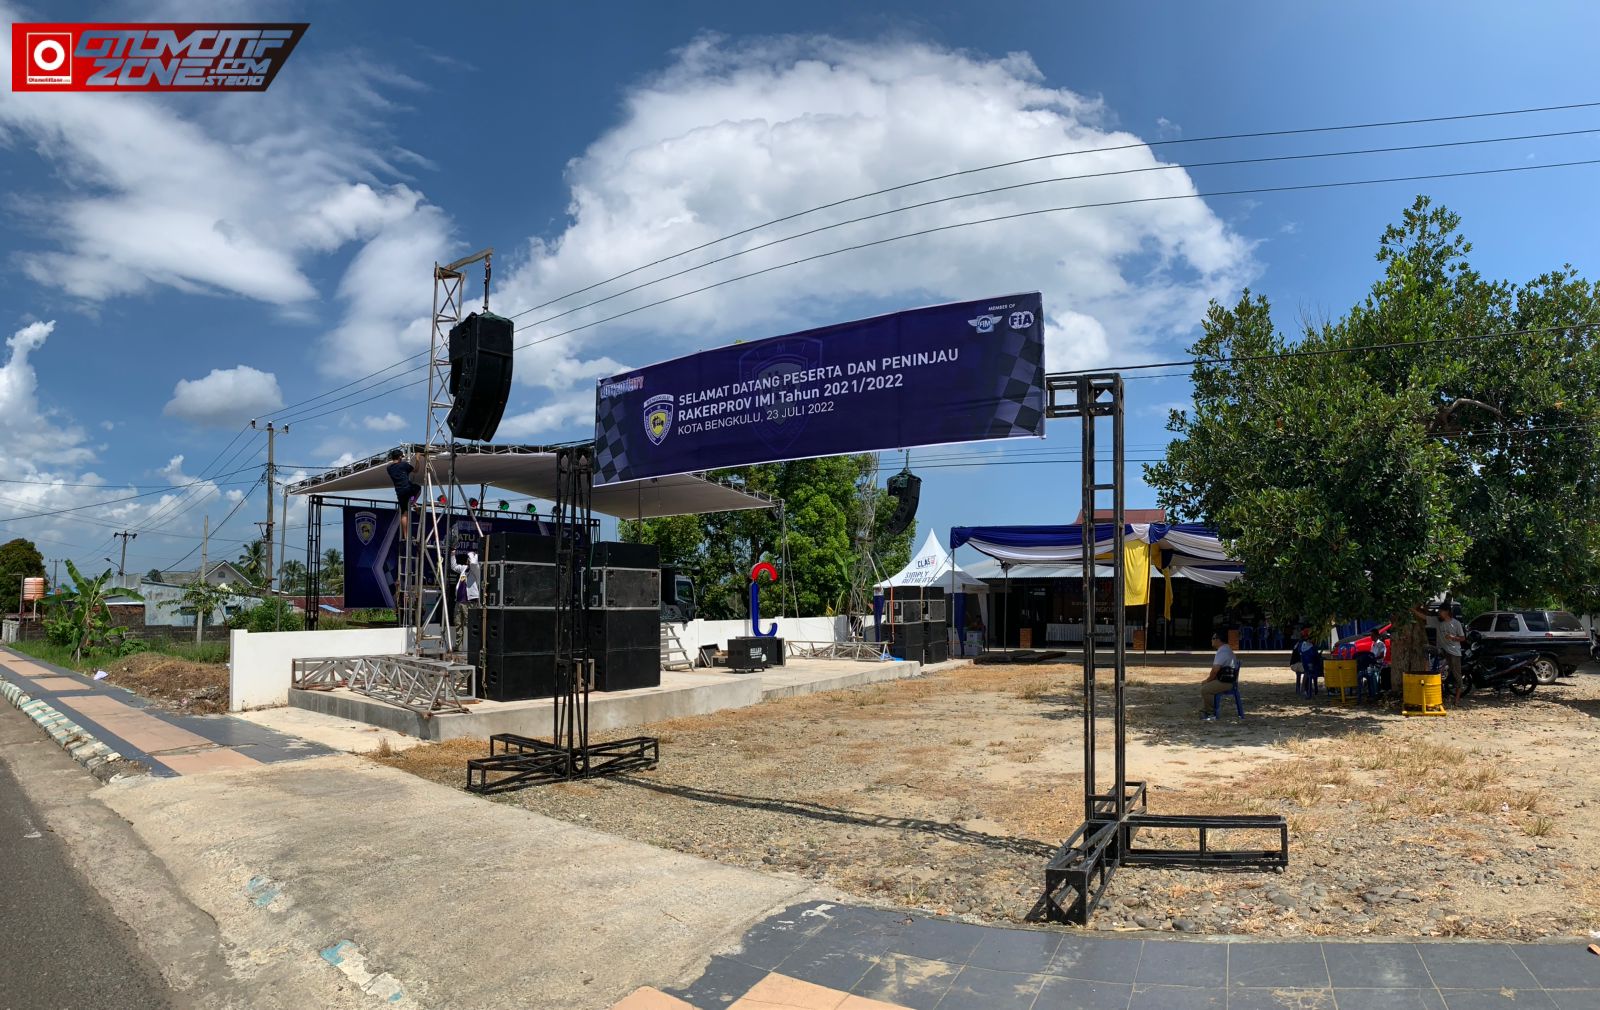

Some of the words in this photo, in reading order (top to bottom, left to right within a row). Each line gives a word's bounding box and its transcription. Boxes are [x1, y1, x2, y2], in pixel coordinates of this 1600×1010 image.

[678, 385, 729, 406] SELAMAT
[732, 375, 780, 396] DATANG
[783, 365, 843, 386] PESERTA
[847, 359, 877, 376] DAN
[882, 348, 959, 371] PENINJAU
[678, 397, 751, 421] RAKERPROV
[755, 393, 775, 407] IMI
[779, 388, 820, 404] Tahun
[824, 374, 903, 397] 2021/2022
[678, 423, 703, 436] KOTA
[704, 412, 763, 432] BENGKULU,
[766, 410, 779, 421] 23
[781, 406, 805, 419] JULI
[808, 401, 834, 414] 2022
